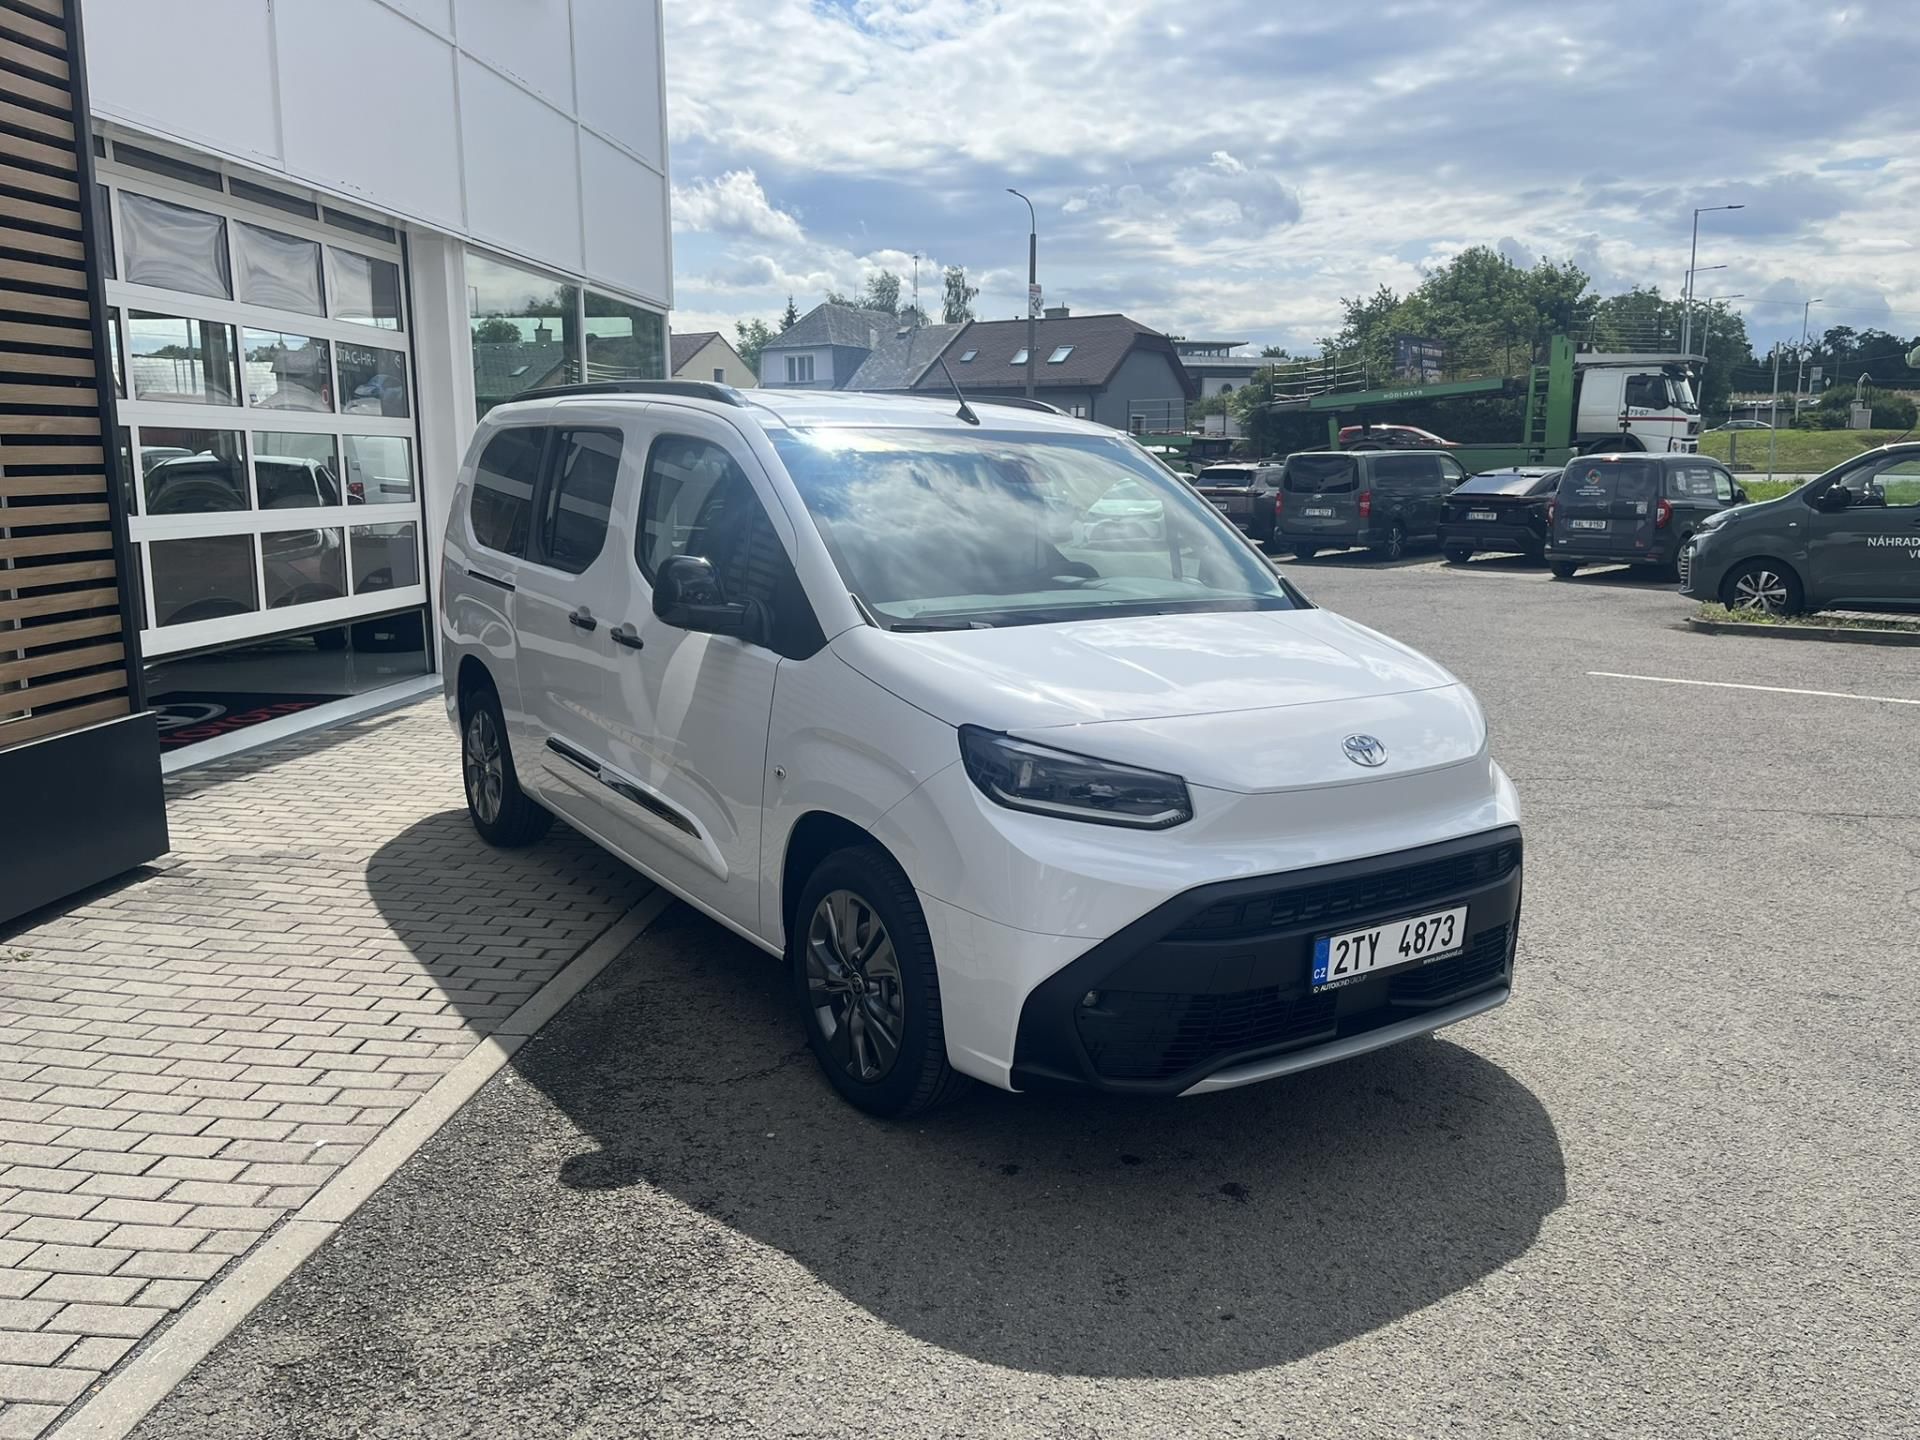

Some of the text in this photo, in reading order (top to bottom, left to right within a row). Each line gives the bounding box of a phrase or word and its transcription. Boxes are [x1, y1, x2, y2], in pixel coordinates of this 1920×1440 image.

[1334, 914, 1455, 976] 2TY 4873
[1313, 967, 1327, 979] CZ
